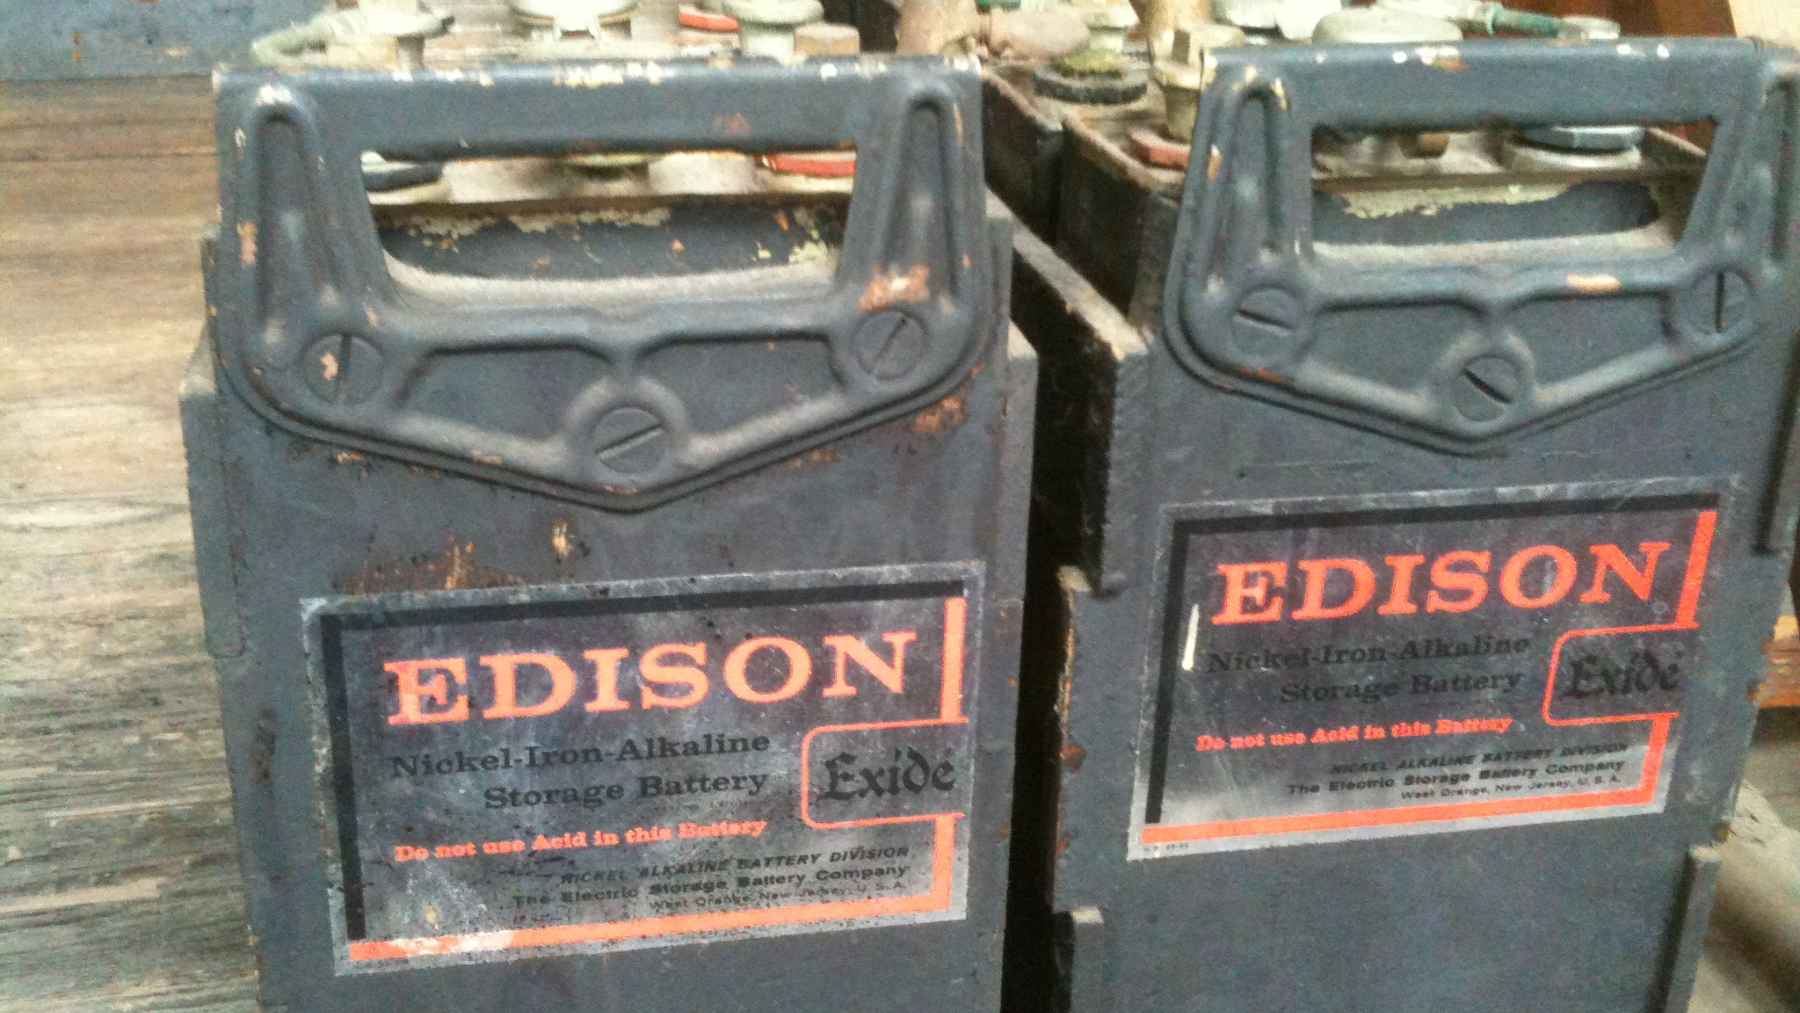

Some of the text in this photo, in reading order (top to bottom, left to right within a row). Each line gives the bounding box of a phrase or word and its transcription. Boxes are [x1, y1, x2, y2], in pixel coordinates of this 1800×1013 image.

[1210, 541, 1672, 625] EDISON
[1207, 635, 1530, 673] Nickel-Iron-Alkaline
[383, 628, 917, 726] EDISON
[1279, 672, 1523, 703] Storage Battery
[1560, 650, 1680, 699] Exide
[1196, 715, 1514, 752] Do not use Acid in this Battery
[391, 733, 769, 778] Nickel-Iron-Alkaline
[818, 746, 956, 801] Exide
[1398, 754, 1476, 770] ALKALINE
[484, 773, 768, 810] Storage Battery
[1289, 760, 1625, 795] The Electric Storage Battery Company
[394, 820, 768, 863] Do not use Acid in this Battery
[639, 856, 733, 878] ALKALINE
[737, 853, 822, 871] BATTERY
[828, 846, 910, 863] DIVISION
[561, 886, 638, 903] Electric
[649, 880, 728, 896] Storage
[736, 873, 806, 889] Battery
[815, 865, 911, 881] Company
